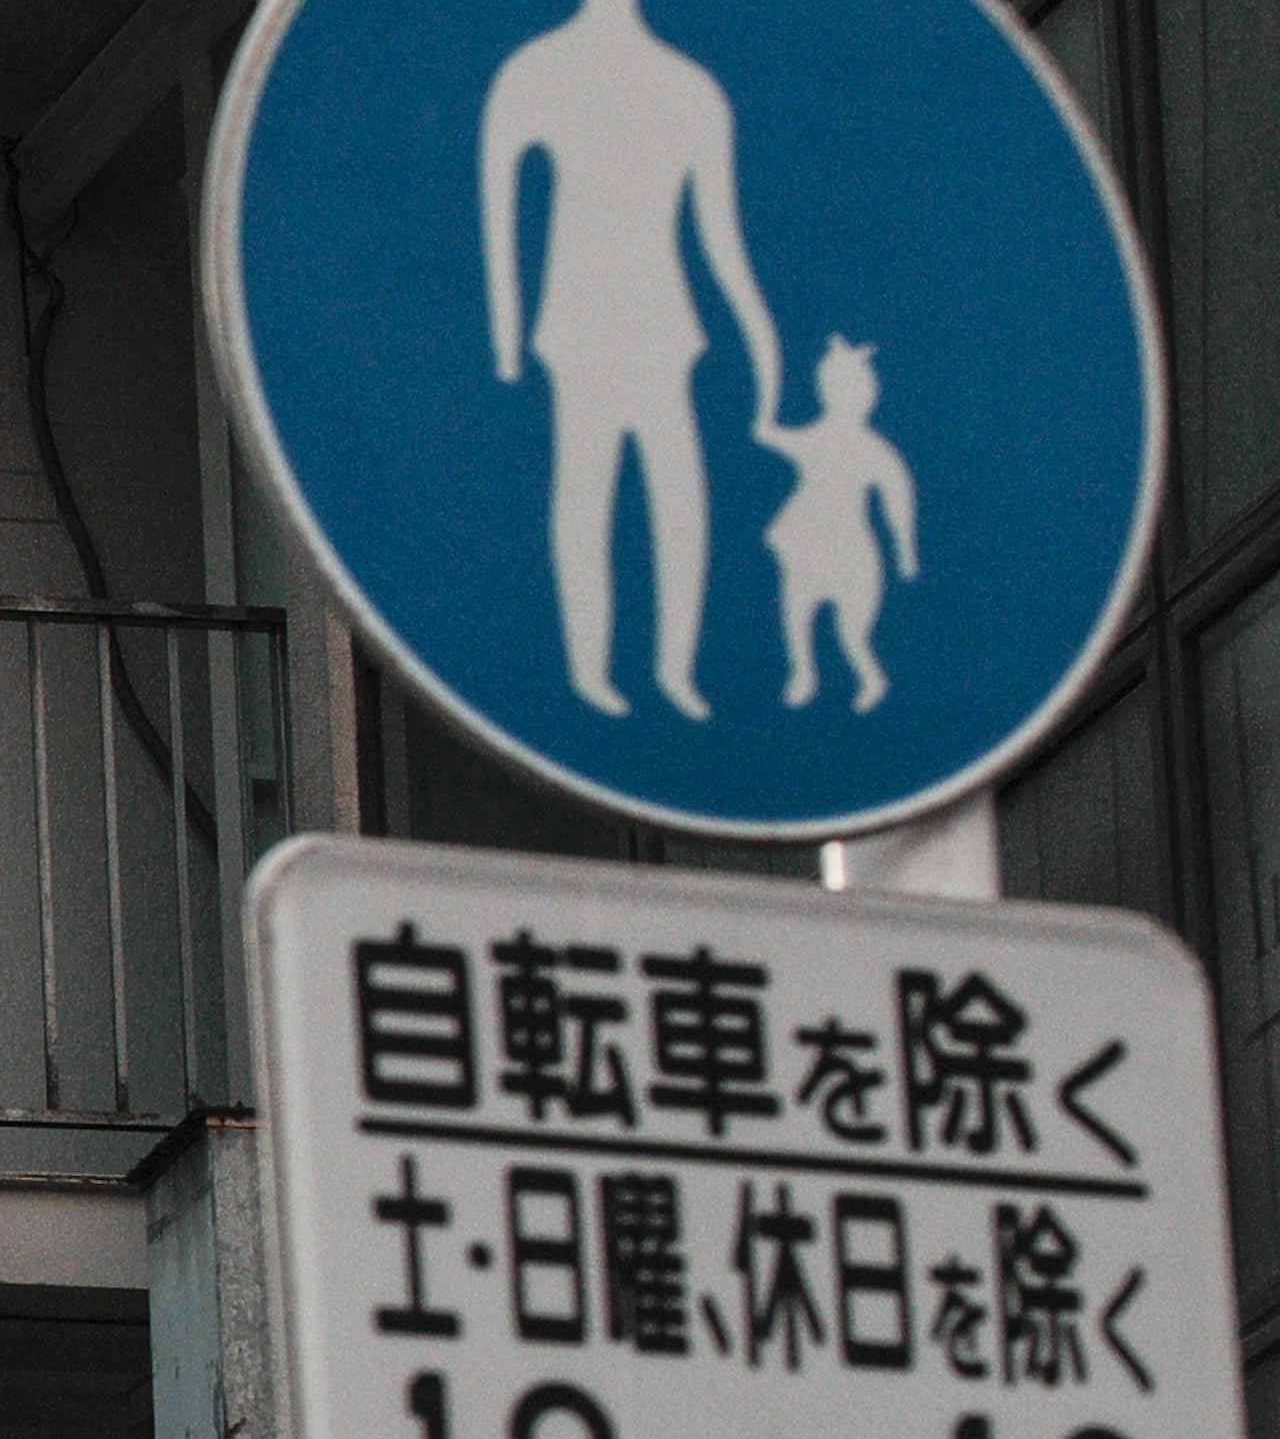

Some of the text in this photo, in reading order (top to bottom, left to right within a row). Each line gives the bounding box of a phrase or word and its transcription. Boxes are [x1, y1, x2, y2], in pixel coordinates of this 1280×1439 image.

[352, 921, 1138, 1168] 自転車を除く
